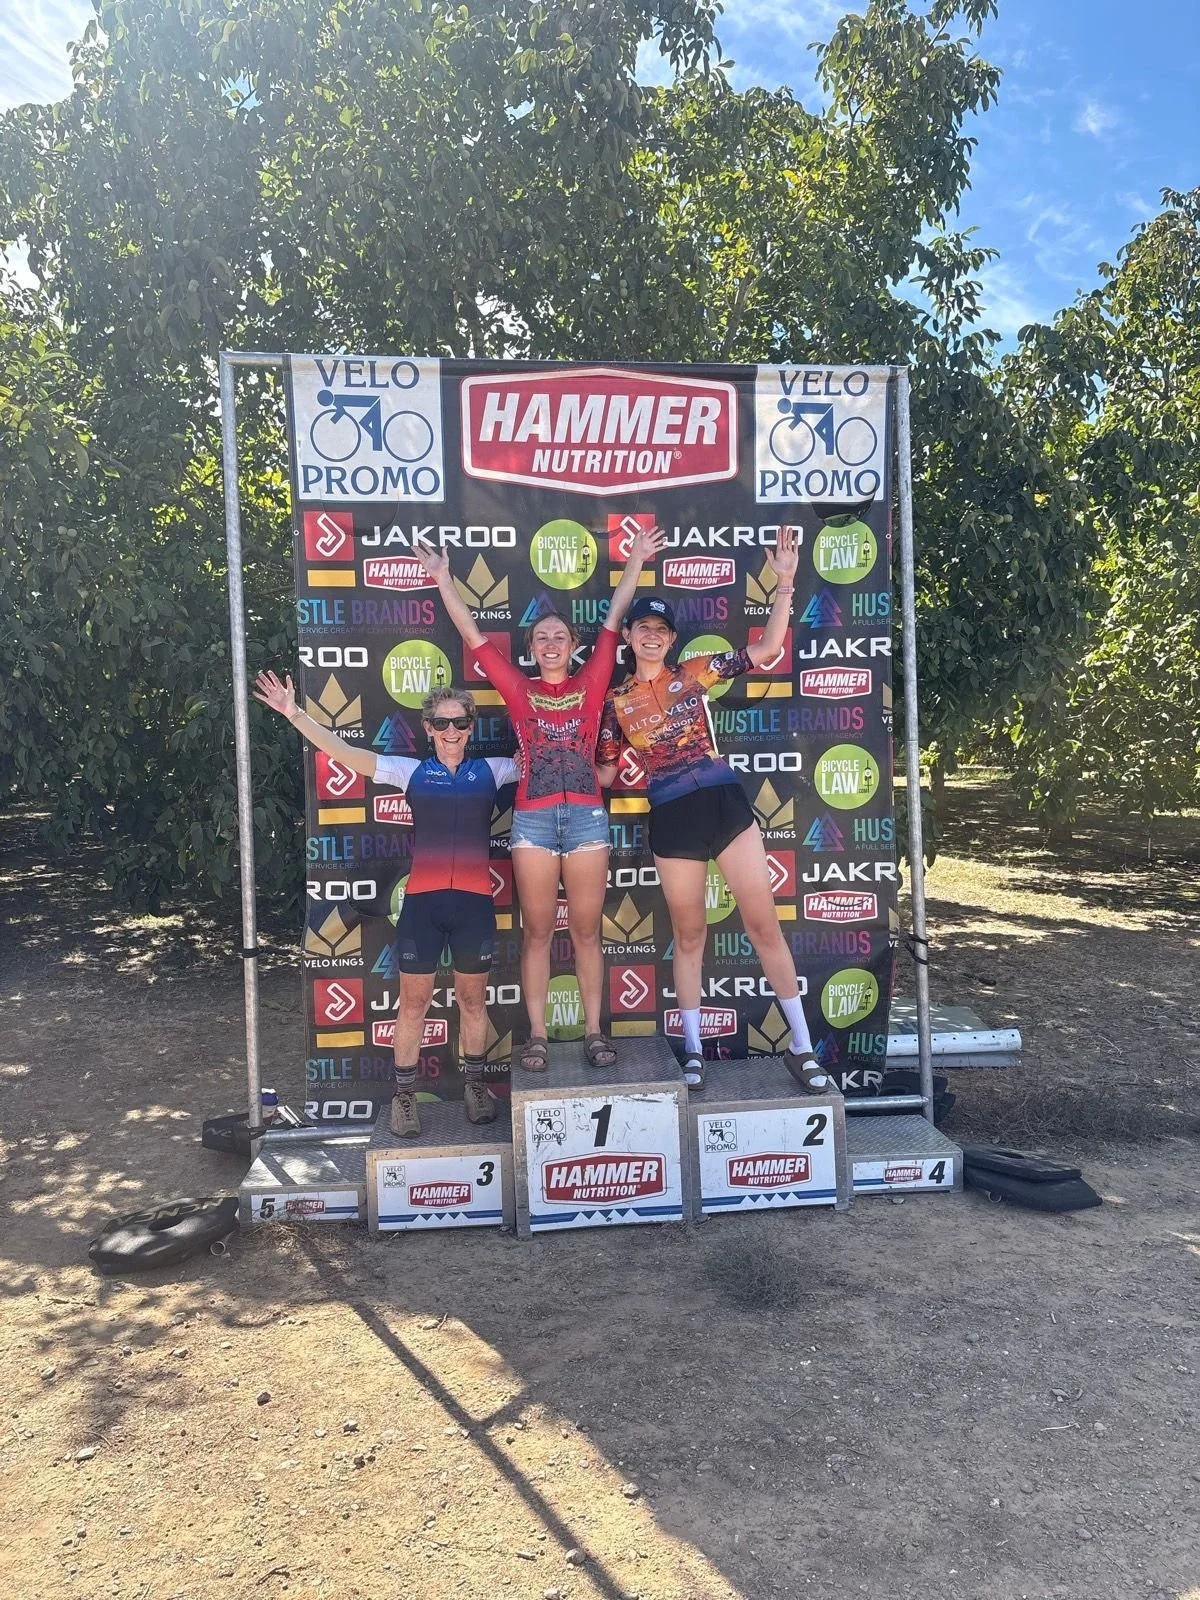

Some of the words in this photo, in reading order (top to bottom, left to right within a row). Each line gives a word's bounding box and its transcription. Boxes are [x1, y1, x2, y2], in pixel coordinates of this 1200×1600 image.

[314, 359, 420, 389] VELO
[779, 370, 870, 397] VELO
[479, 392, 722, 445] HAMMER
[301, 465, 441, 496] PROMO
[759, 469, 881, 497] PROMO
[361, 525, 517, 548] JAKROO
[537, 536, 578, 550] BICYCLE
[819, 533, 859, 549] BICYCLE
[538, 550, 577, 574] LAW
[819, 546, 858, 571] LAW
[368, 562, 431, 578] HAMME
[667, 562, 731, 578] HAMMER
[384, 578, 423, 586] NUTRITION
[680, 577, 719, 585] NUTRITION
[351, 599, 435, 625] BRANDS
[743, 606, 765, 615] VELO
[852, 592, 892, 617] HUS
[481, 610, 512, 620] KINGS
[799, 636, 892, 660] JAKR
[390, 656, 432, 669] BICYCLE
[390, 669, 432, 693] LAW
[804, 672, 868, 688] HAMMER
[818, 687, 856, 695] NUTRITION
[629, 714, 662, 733] ALTO
[664, 697, 698, 716] VELO
[714, 708, 781, 734] HUSTLE
[787, 705, 864, 732] BRANDS
[537, 718, 581, 733] Reliable
[662, 717, 694, 734] Action
[735, 735, 765, 743] SERVICE
[728, 752, 802, 773] ROO
[821, 759, 860, 772] BICYCLE
[821, 772, 860, 795] LAW
[378, 799, 412, 813] HAM
[766, 830, 797, 839] KINGS
[854, 817, 895, 842] HUS
[802, 862, 898, 883] JAKR
[808, 896, 873, 911] HAMMER
[601, 946, 625, 955] VELO
[626, 944, 657, 954] KINGS
[792, 930, 871, 954] BRANDS
[303, 959, 331, 968] VELO
[331, 957, 365, 967] KINGS
[547, 990, 580, 1004] ICYCLE
[828, 983, 866, 997] BICYCLE
[828, 995, 862, 1018] LAW
[536, 1110, 561, 1118] VELO
[590, 1104, 613, 1147] 1
[709, 1120, 732, 1129] VELO
[802, 1113, 828, 1147] 2
[533, 1132, 566, 1141] PROMO
[705, 1142, 737, 1152] PROMO
[476, 1161, 495, 1187] 3
[550, 1160, 659, 1189] HAMMER
[732, 1157, 807, 1178] HAMMER
[886, 1168, 921, 1178] HAMMER
[928, 1160, 946, 1184] 4
[747, 1175, 792, 1185] NUTRITION
[412, 1185, 469, 1200] HAMMER
[573, 1184, 638, 1200] NUTRITION
[260, 1197, 276, 1219] 5
[423, 1198, 458, 1206] NUTRITION
